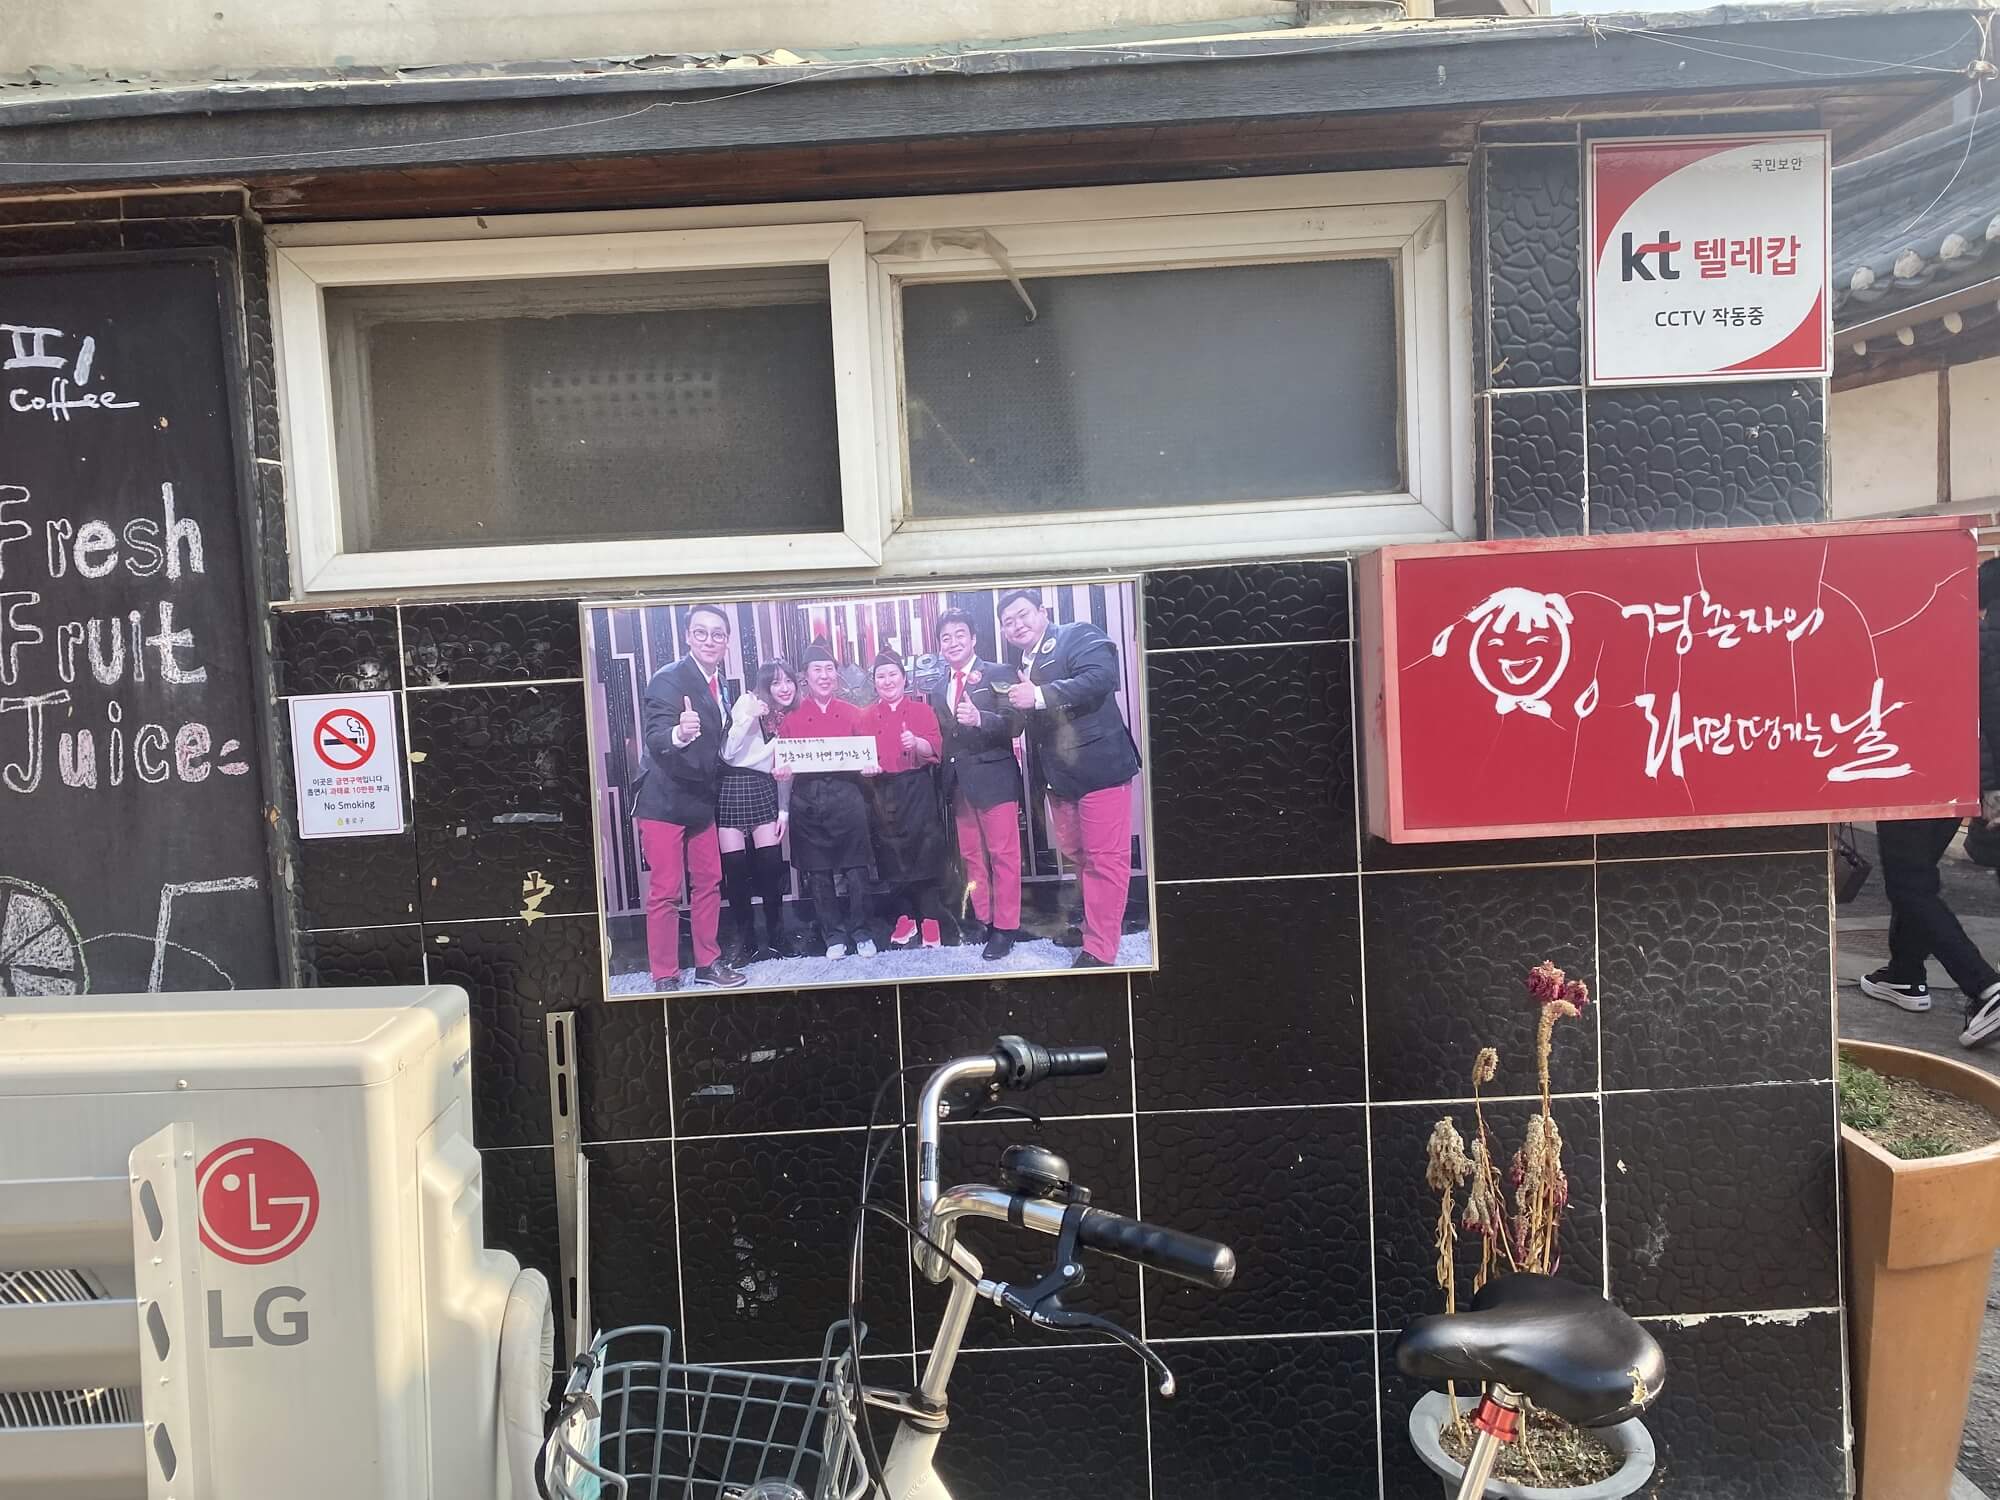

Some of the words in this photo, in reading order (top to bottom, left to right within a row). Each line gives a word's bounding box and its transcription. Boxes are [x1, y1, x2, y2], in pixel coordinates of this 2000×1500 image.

[1751, 157, 1803, 173] 국민보안
[1694, 235, 1801, 279] 텔레캅
[1655, 310, 1706, 327] CCTV
[1712, 306, 1765, 327] 작동중
[0, 591, 207, 686] Fruit
[0, 690, 212, 793] Juice
[312, 777, 333, 786] 이곳은
[336, 775, 382, 786] 금연구역입니다
[324, 801, 336, 811] No
[338, 800, 376, 810] Smoking
[206, 1286, 310, 1349] LG
